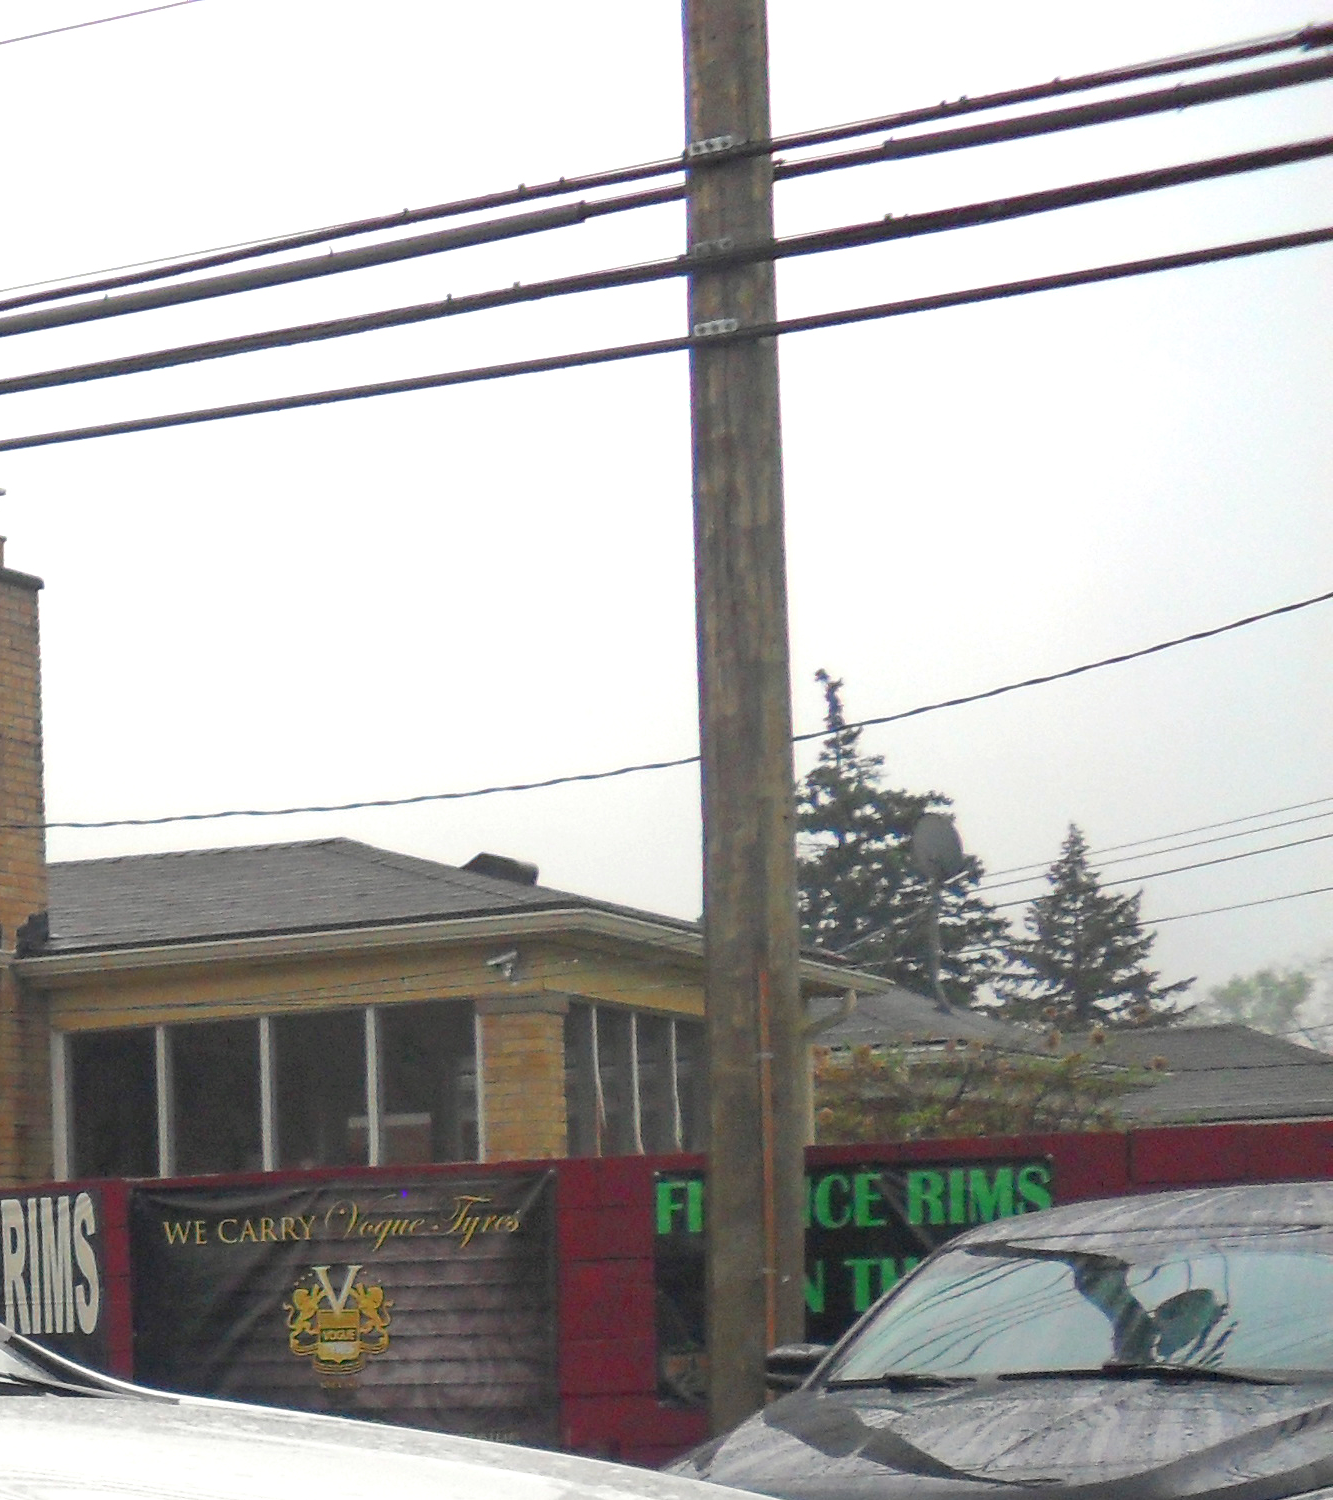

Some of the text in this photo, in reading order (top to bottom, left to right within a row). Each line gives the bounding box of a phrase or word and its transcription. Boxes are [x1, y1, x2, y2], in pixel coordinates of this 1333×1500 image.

[162, 1194, 520, 1252] WE CARRY Vogue Tyres
[907, 1164, 1052, 1226] RIMS
[0, 1192, 101, 1335] RIMS
